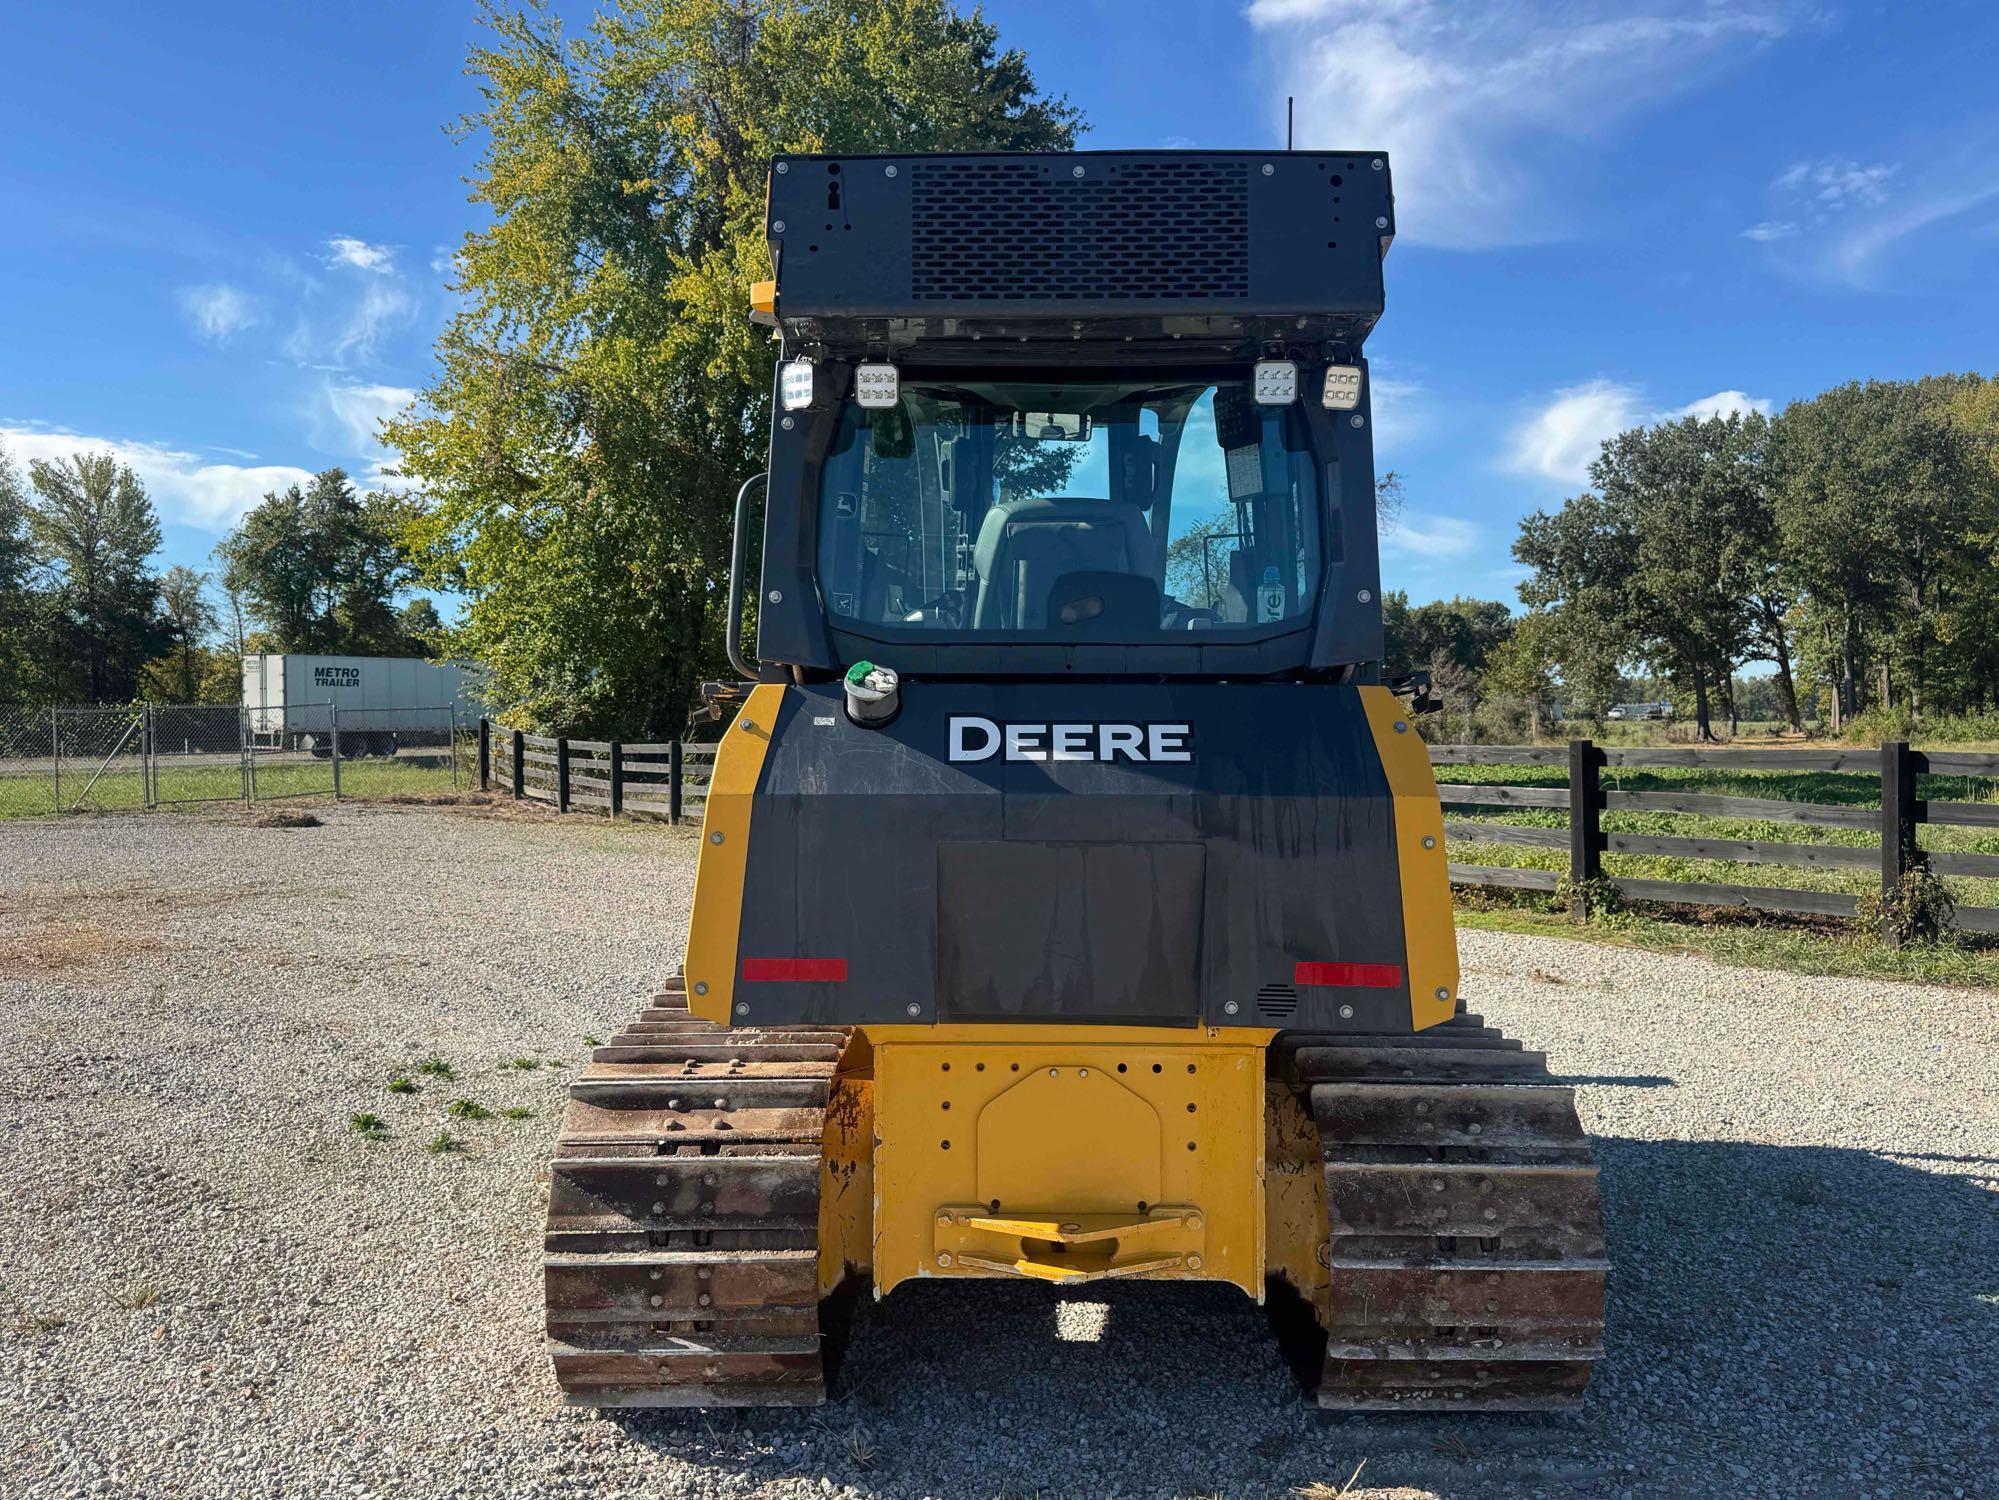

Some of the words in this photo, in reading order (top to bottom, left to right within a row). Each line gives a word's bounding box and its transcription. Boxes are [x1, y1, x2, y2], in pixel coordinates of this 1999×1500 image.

[314, 667, 359, 678] METRO
[315, 678, 360, 687] TRAILER
[949, 716, 1191, 761] DEERE
